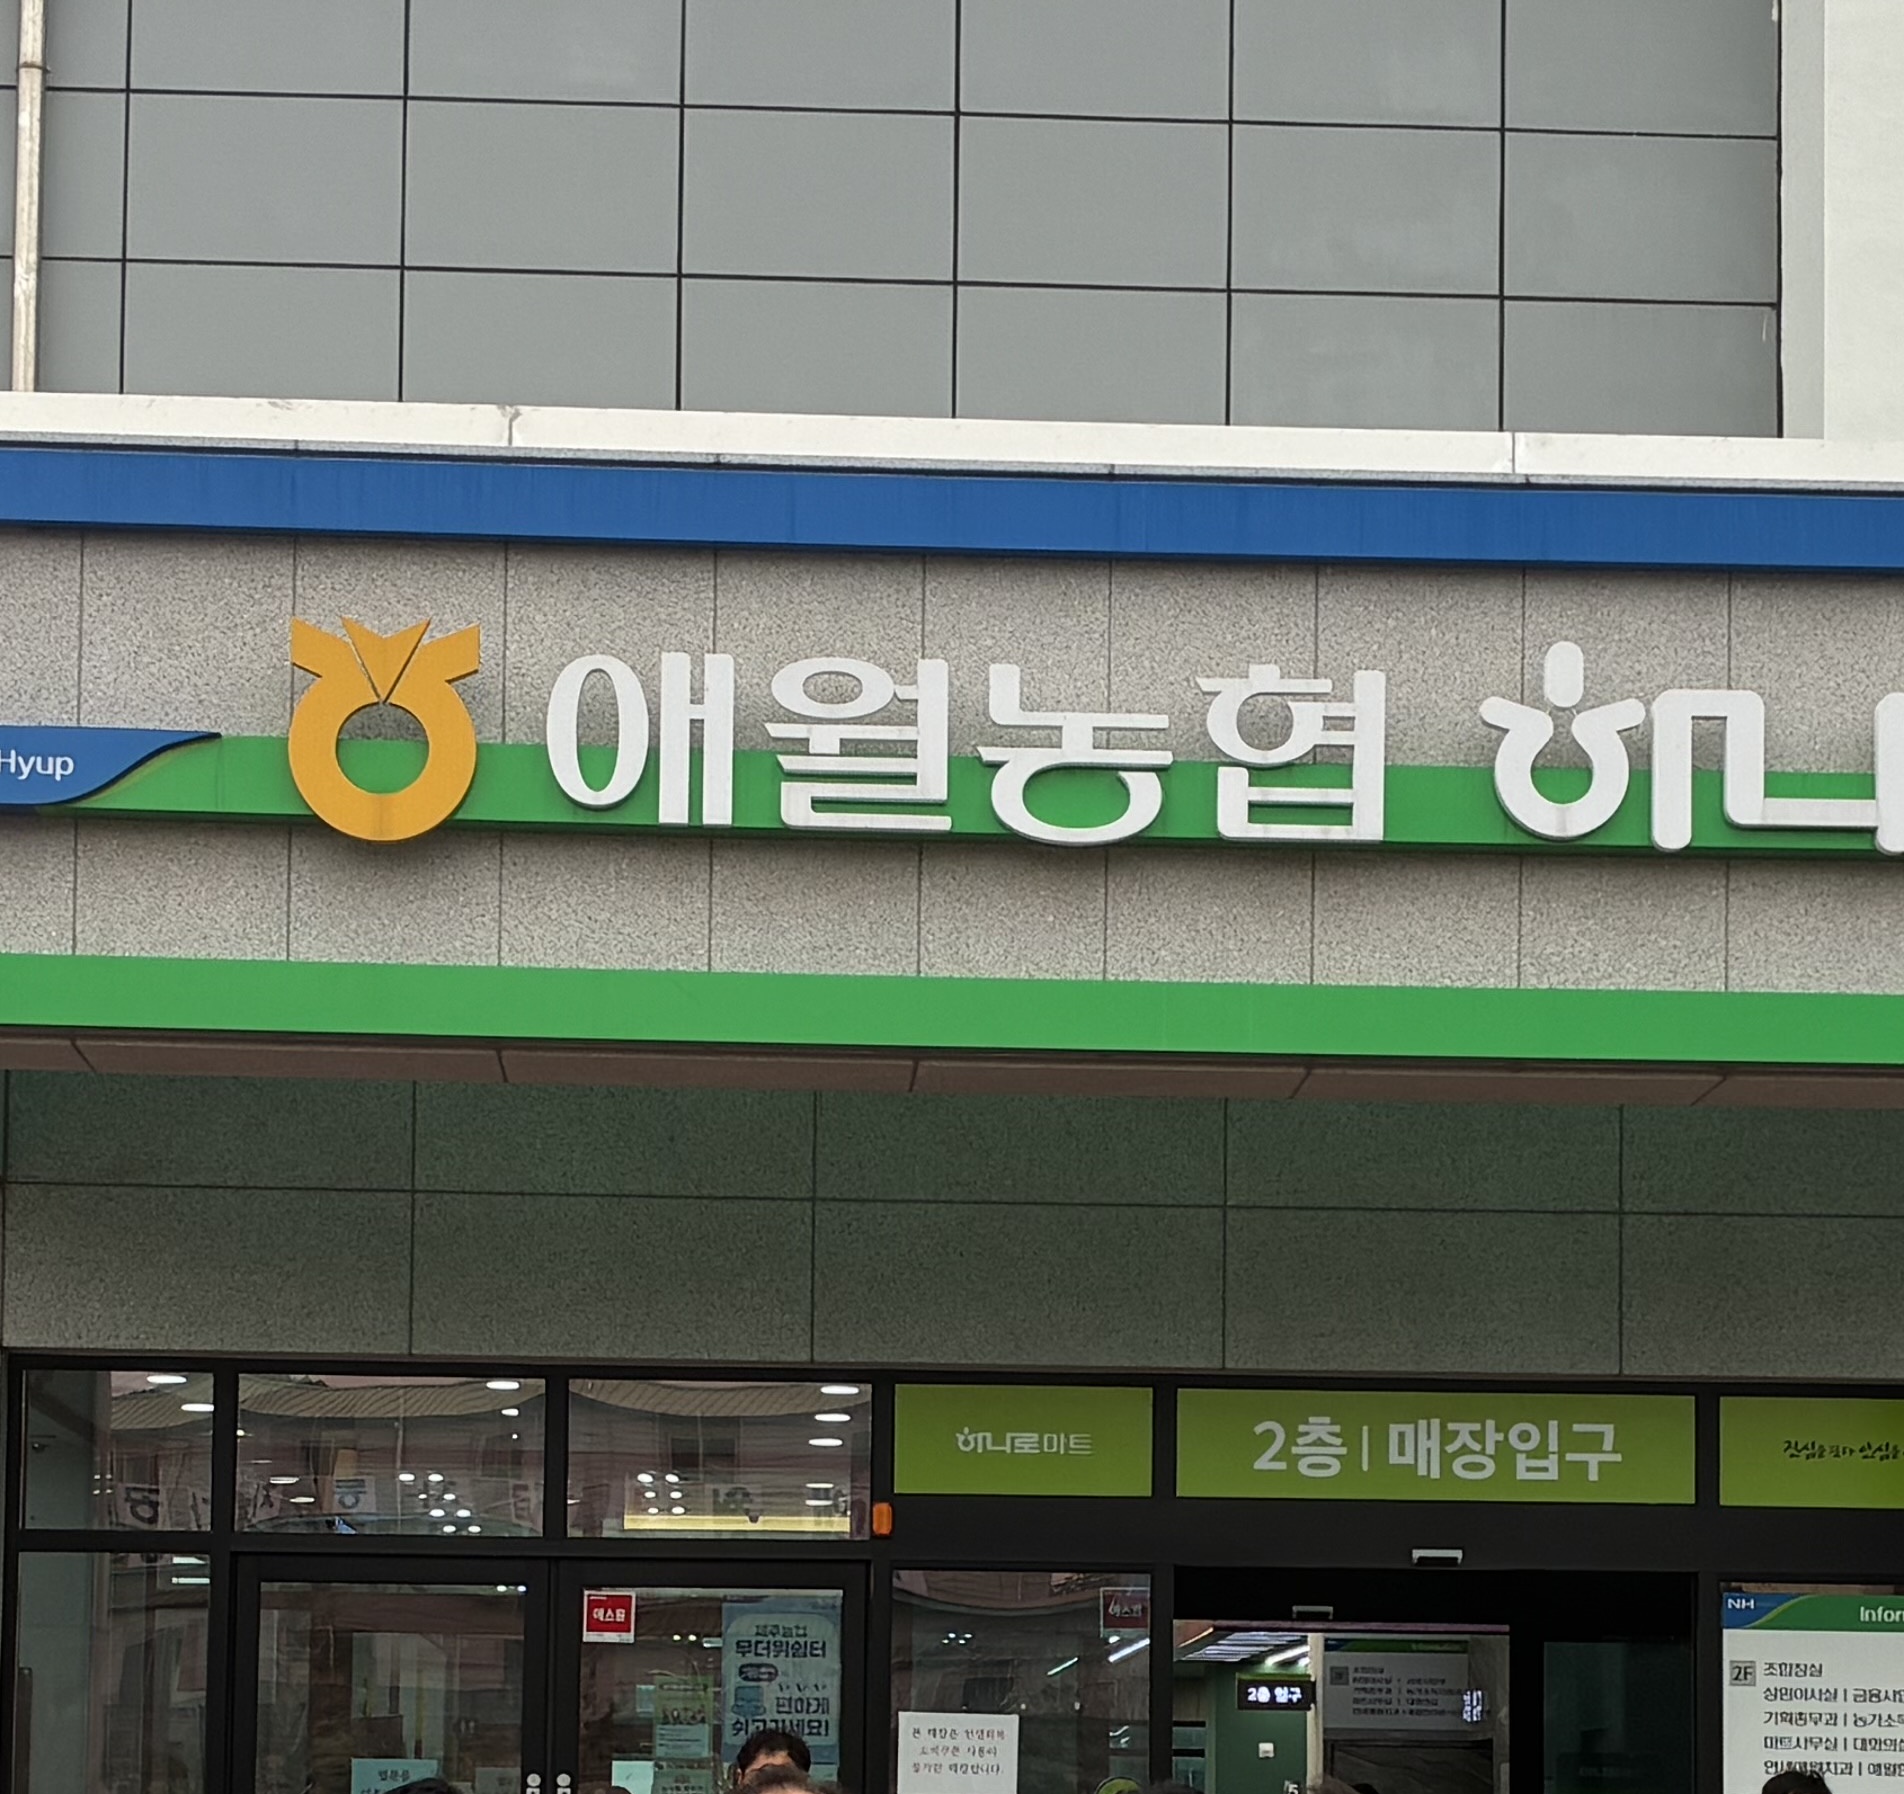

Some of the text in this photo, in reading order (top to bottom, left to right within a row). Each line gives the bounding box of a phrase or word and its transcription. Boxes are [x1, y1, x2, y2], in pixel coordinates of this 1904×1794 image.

[545, 650, 1387, 847] 애월농협
[955, 1426, 1093, 1456] 하나로마트
[1252, 1415, 1623, 1482] 2층 매장입구
[1727, 1598, 1755, 1610] NH
[735, 1640, 827, 1659] 무더위쉼터
[1732, 1665, 1754, 1681] 2F
